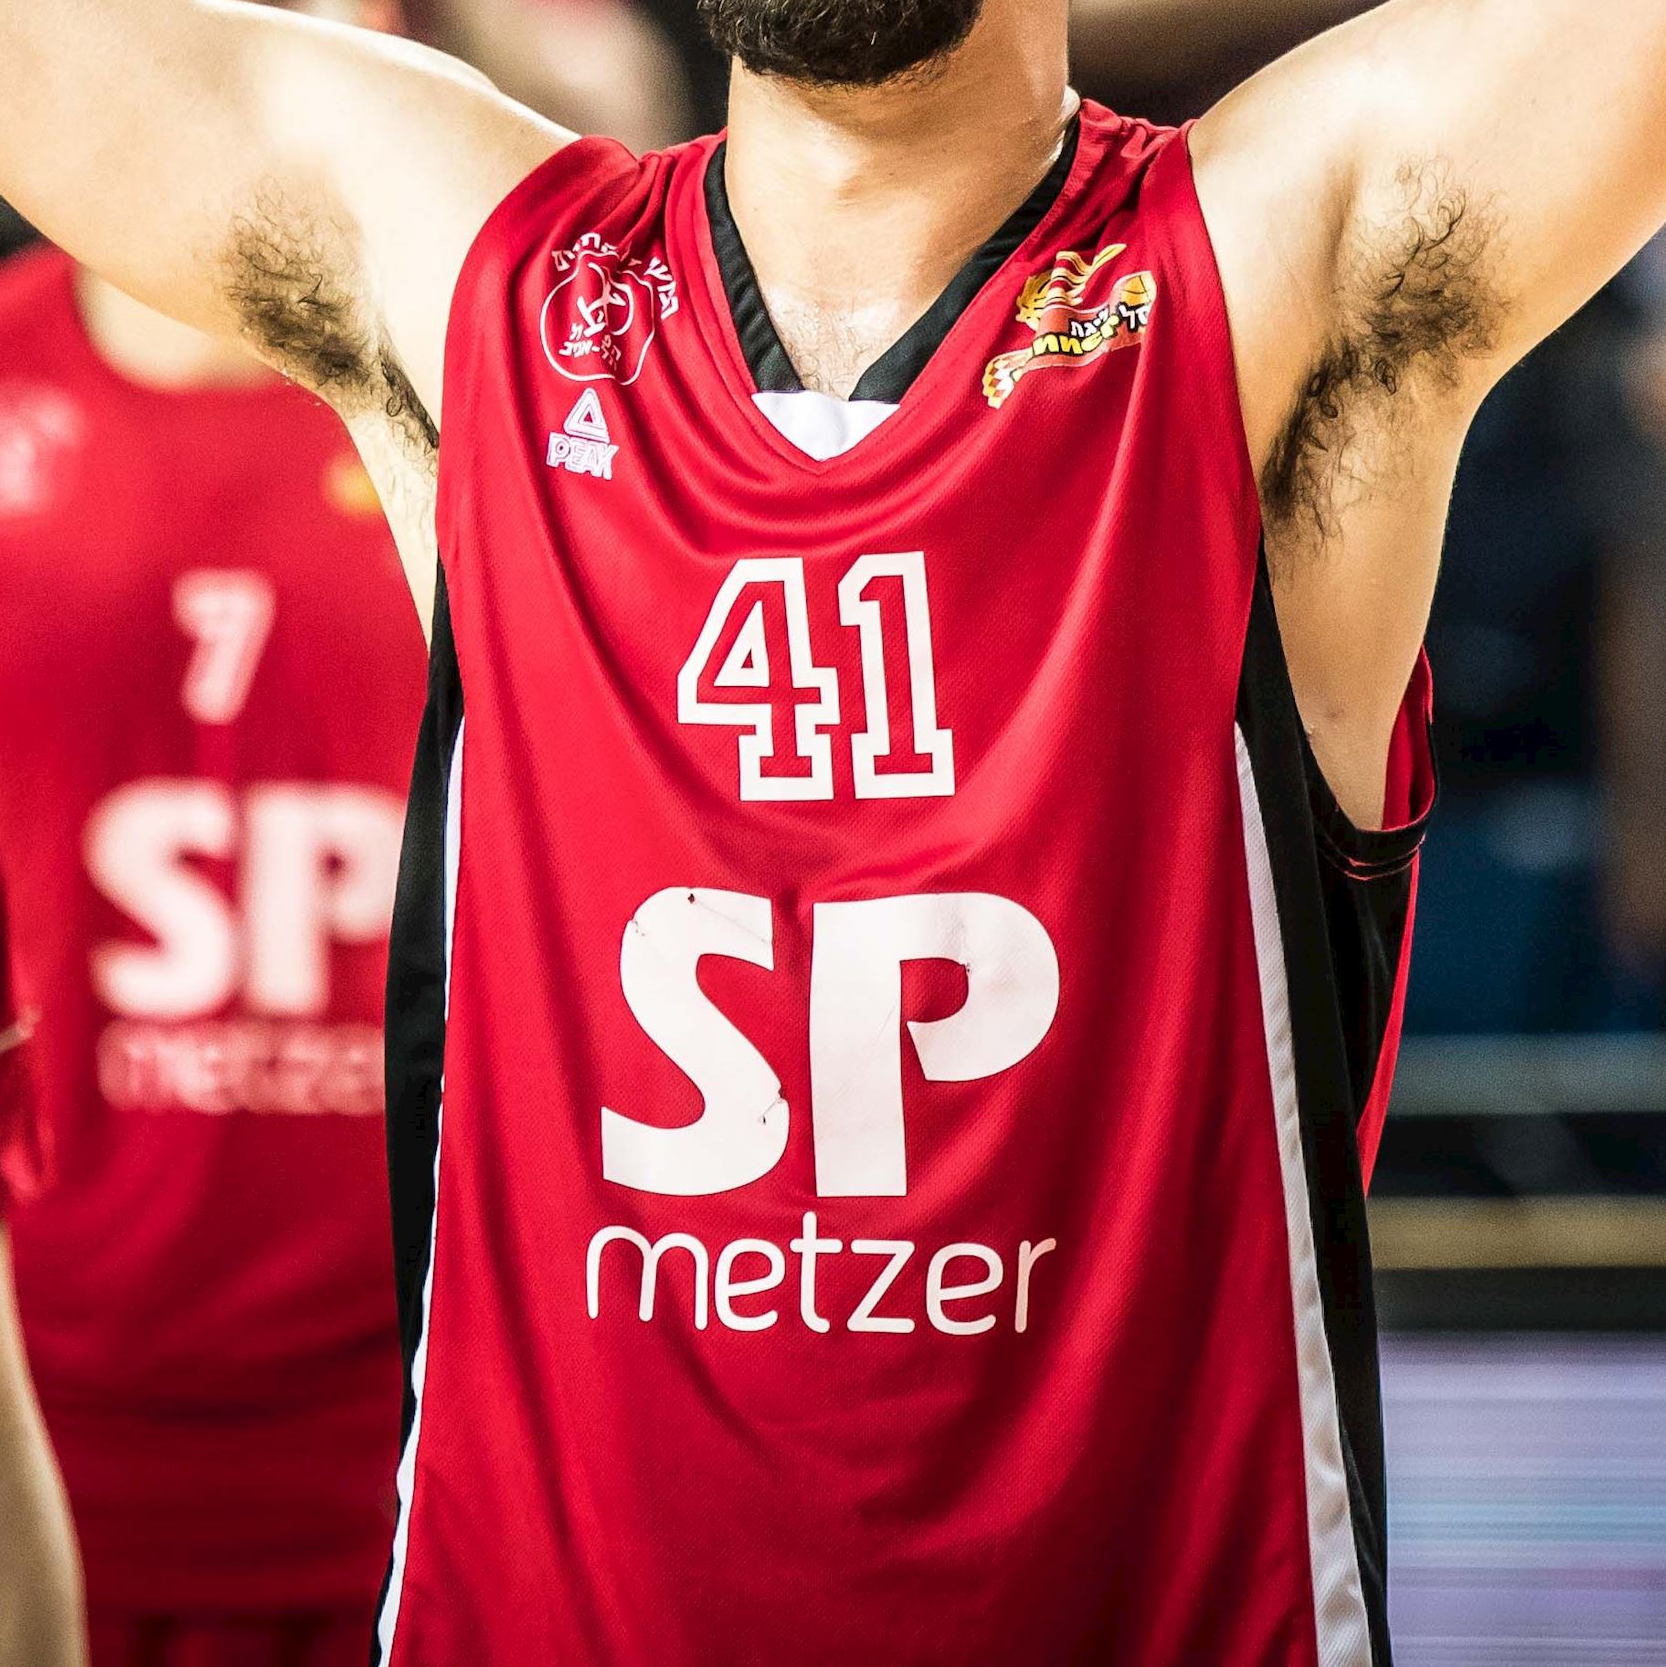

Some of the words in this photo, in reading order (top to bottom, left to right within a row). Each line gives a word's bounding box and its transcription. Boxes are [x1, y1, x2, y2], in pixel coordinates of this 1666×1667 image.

[546, 432, 619, 480] PEAK
[170, 568, 276, 724] 7
[677, 550, 955, 801] 41
[82, 777, 408, 1024] SP
[601, 886, 1060, 1197] SP
[586, 1211, 1057, 1335] metzer
